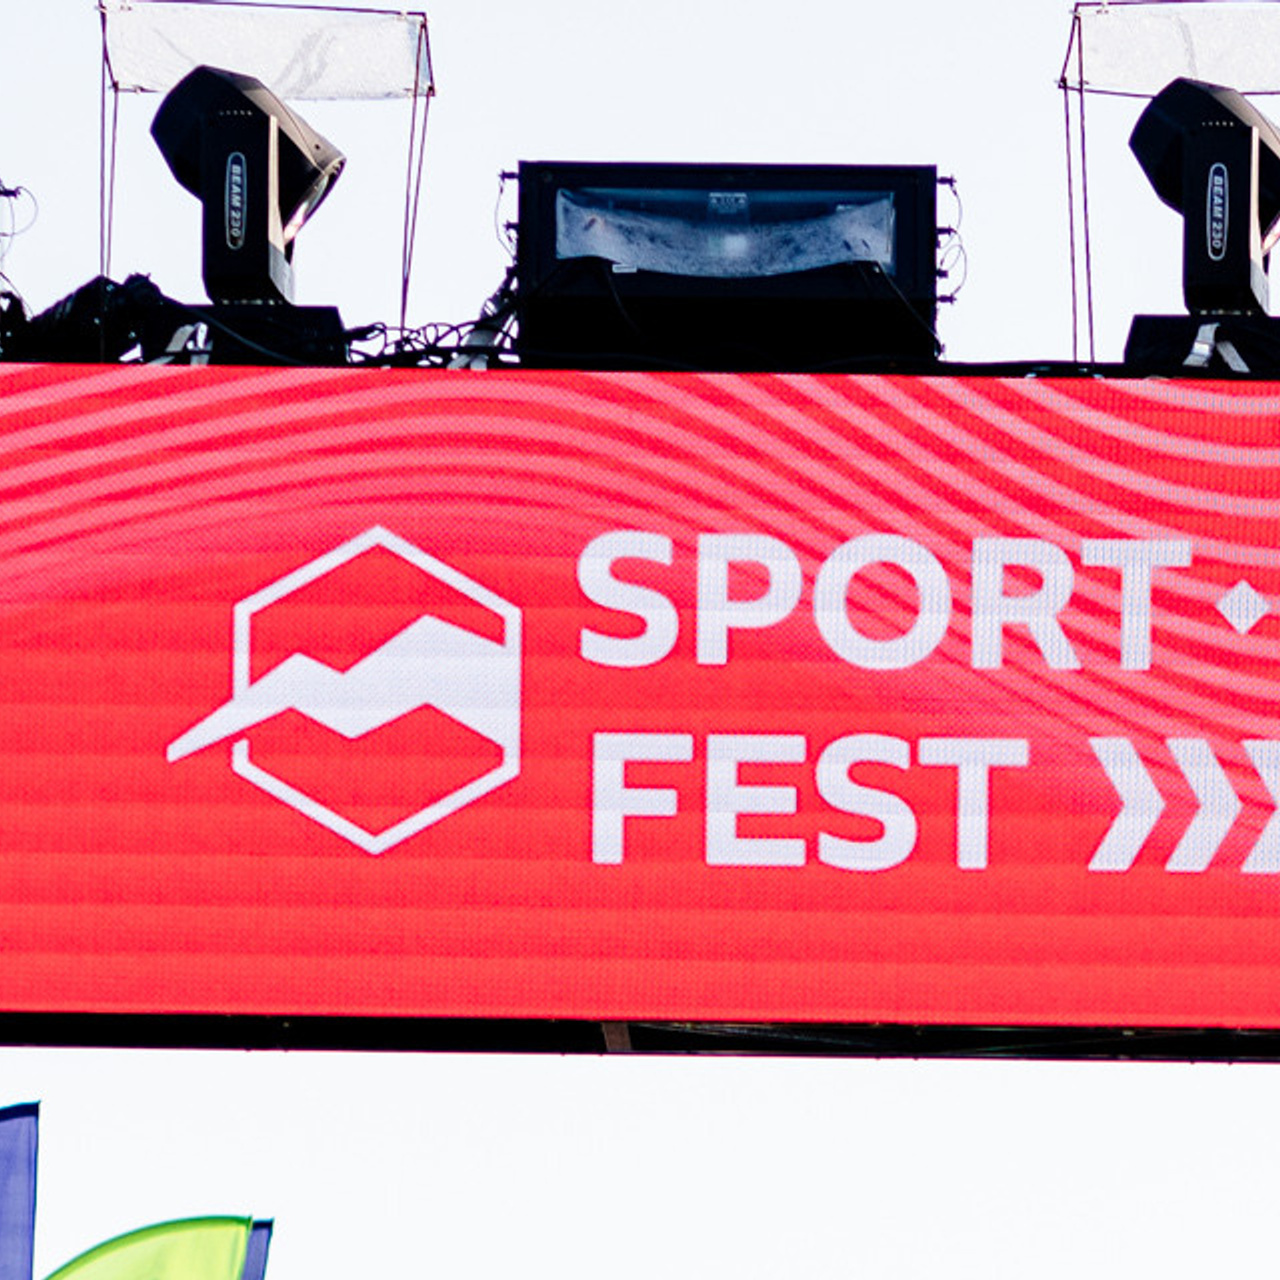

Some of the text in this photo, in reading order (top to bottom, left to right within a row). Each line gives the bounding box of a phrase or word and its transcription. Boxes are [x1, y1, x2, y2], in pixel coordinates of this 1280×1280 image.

[230, 164, 243, 237] BEAM 230
[1211, 174, 1222, 249] BEAM 230
[591, 732, 1031, 873] FEST
